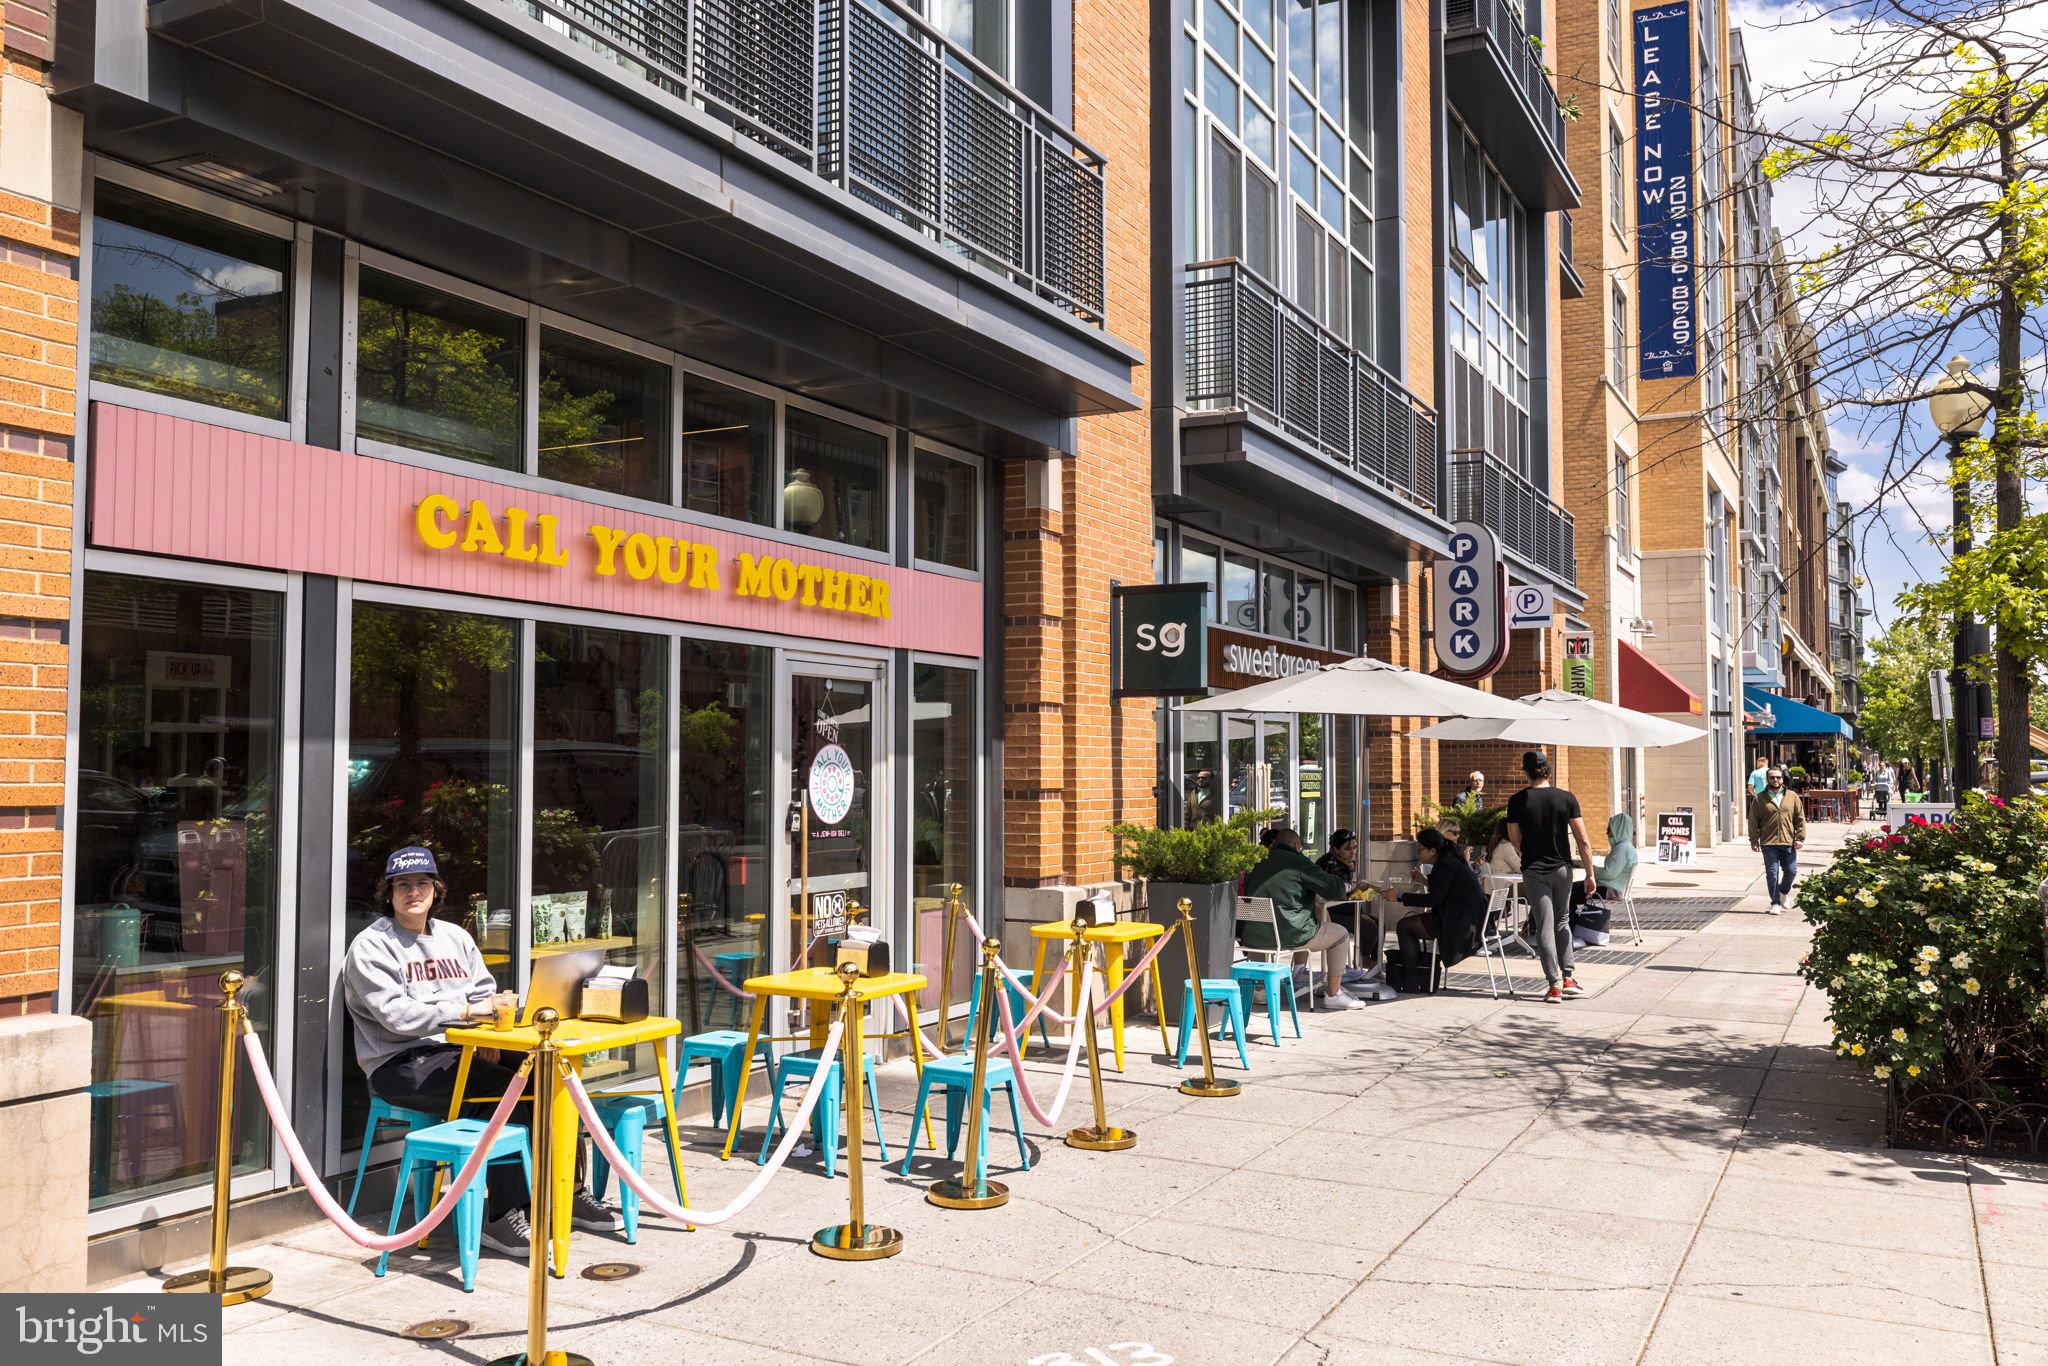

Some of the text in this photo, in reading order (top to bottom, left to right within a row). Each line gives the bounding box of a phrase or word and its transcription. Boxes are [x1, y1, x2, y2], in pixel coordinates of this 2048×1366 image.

[1642, 27, 1665, 205] LEASE NOW
[415, 494, 892, 620] CALL YOUR MOTHER
[1454, 539, 1474, 654] PARK
[1136, 622, 1188, 658] sg
[816, 719, 839, 745] OPEN
[813, 749, 851, 778] CALL YOUR
[815, 798, 848, 820] MOTHER
[1668, 817, 1684, 826] CELL
[1661, 826, 1690, 836] PHONES
[392, 857, 430, 870] Peppers
[815, 895, 832, 920] NO
[815, 919, 826, 930] PETS
